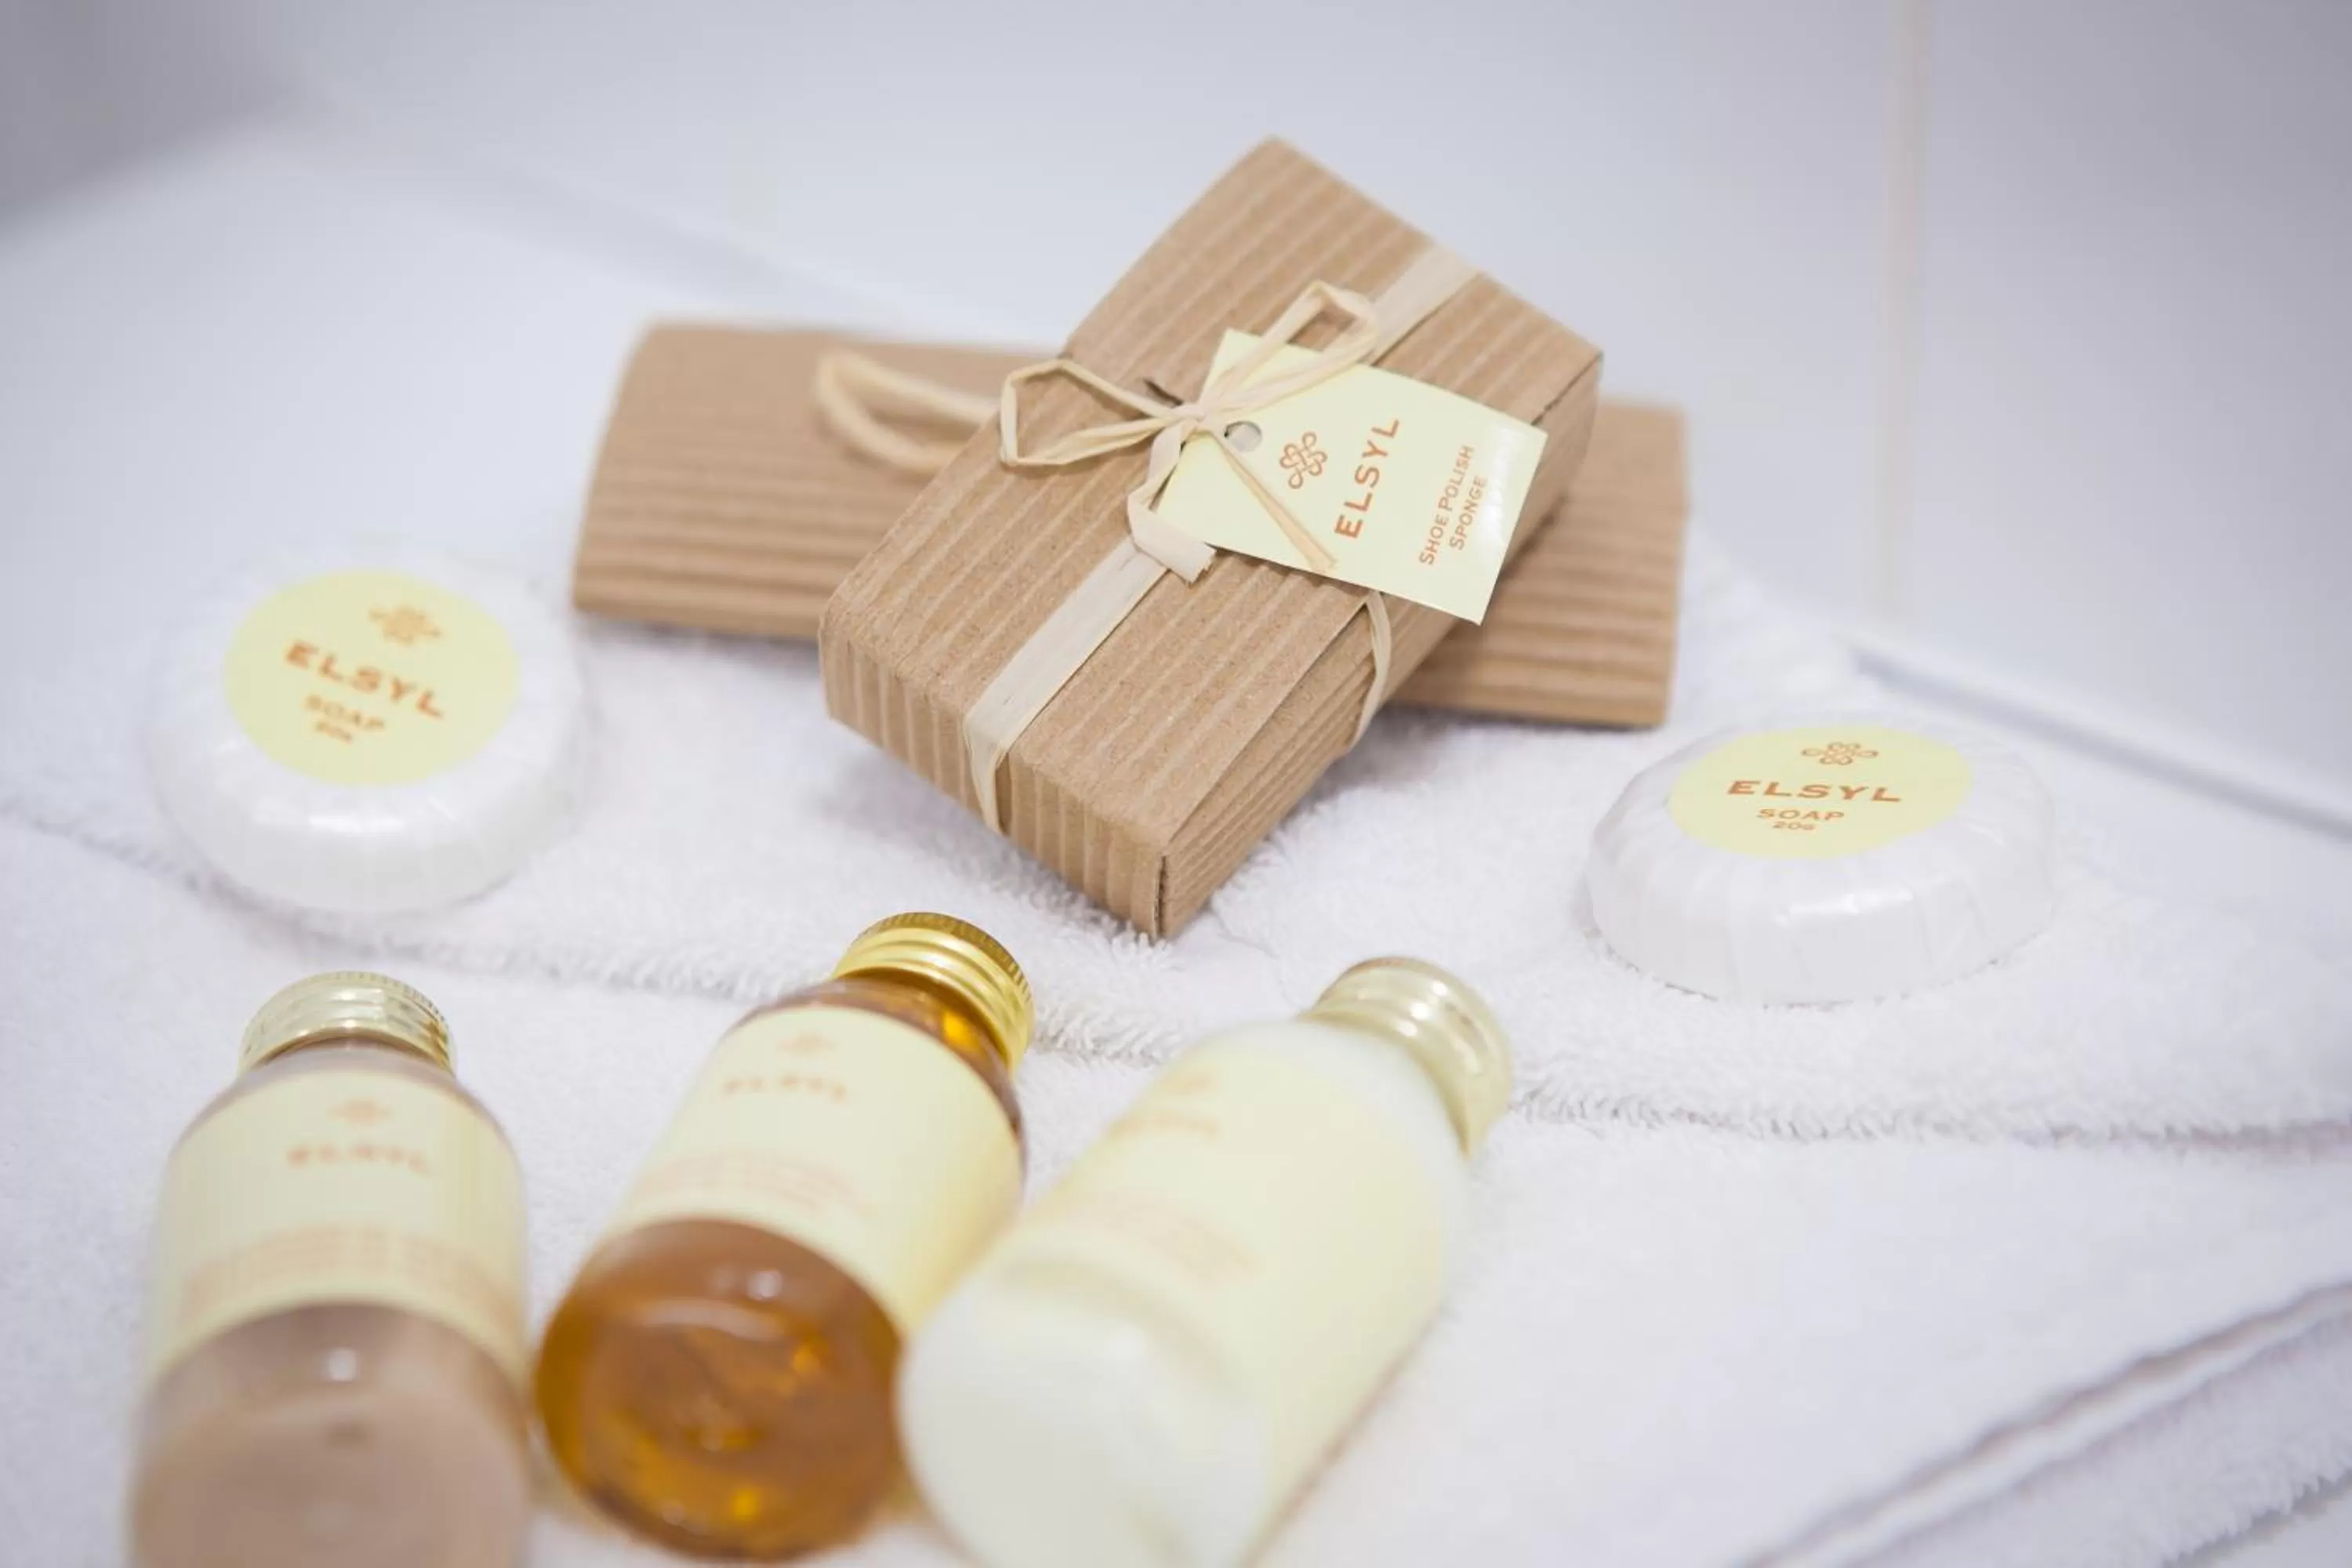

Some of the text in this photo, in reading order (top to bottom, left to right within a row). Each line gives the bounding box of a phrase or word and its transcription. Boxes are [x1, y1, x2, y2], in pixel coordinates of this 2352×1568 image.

[1334, 419, 1399, 539] ELSYL
[1419, 445, 1475, 564] SHOE POLISH
[1449, 476, 1487, 550] SPONGE
[286, 642, 444, 719] ELSYL
[1727, 780, 1902, 803] ELSYL
[1756, 808, 1844, 820] SOAP
